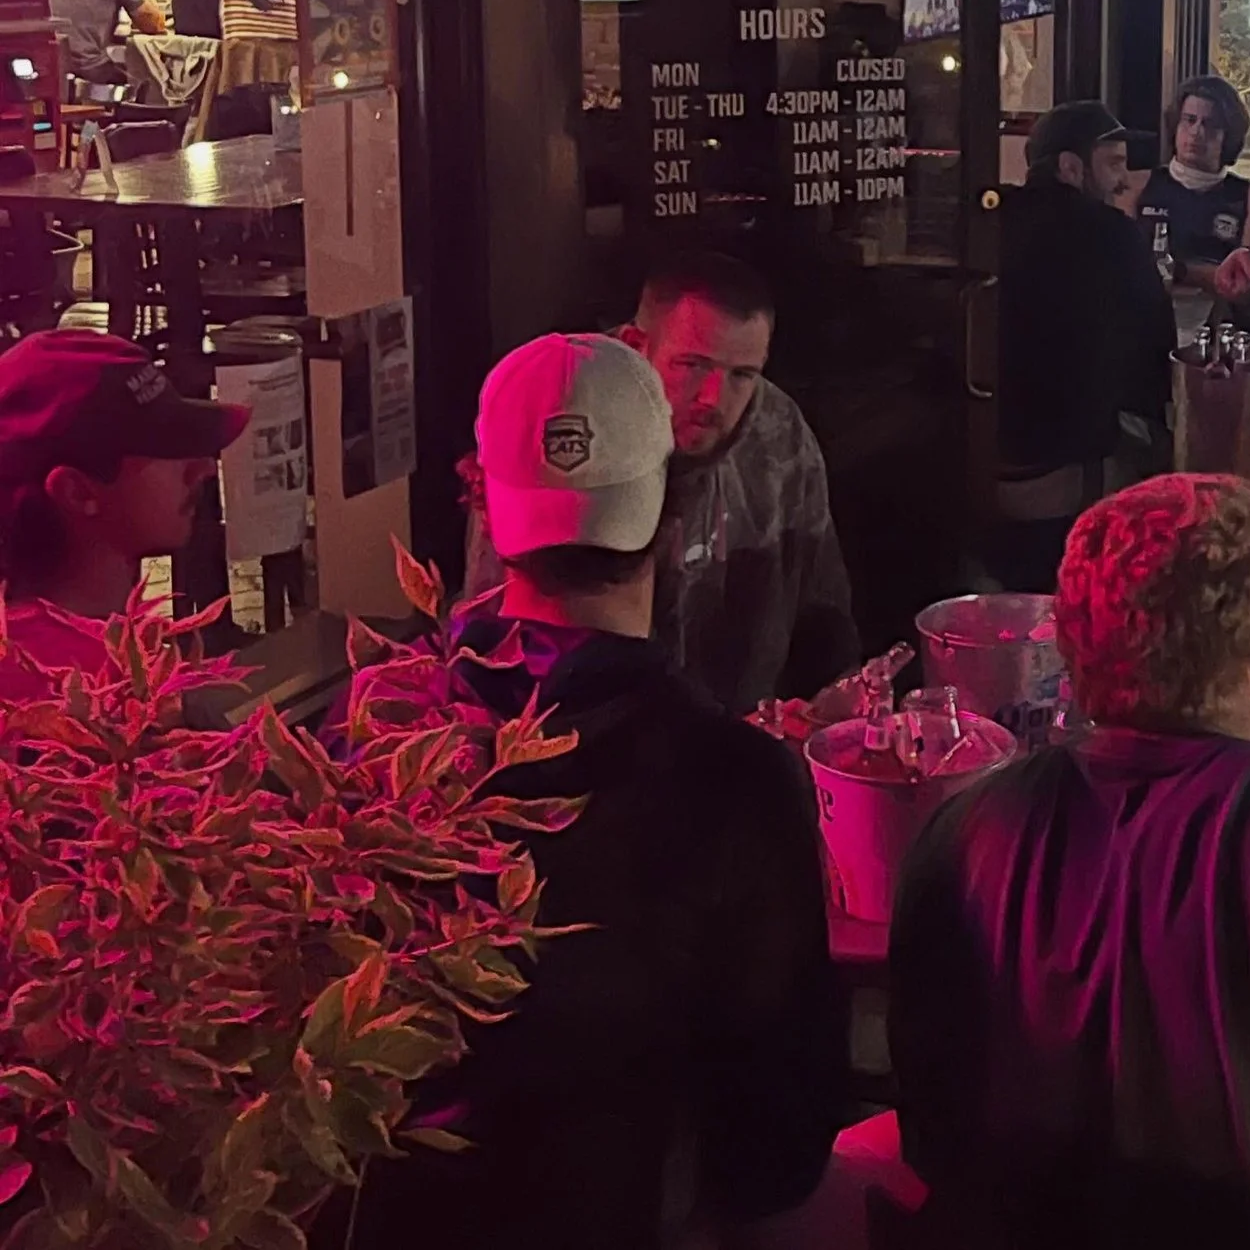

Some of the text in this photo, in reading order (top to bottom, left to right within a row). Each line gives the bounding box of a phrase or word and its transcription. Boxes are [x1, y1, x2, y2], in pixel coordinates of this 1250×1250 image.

[740, 8, 826, 41] HOURS
[652, 58, 905, 88] MON CLOSED
[652, 95, 689, 121] TUE
[707, 93, 745, 117] THU
[766, 90, 839, 115] 4:30PM
[856, 88, 905, 112] 12AM
[654, 128, 685, 151] FRI
[793, 120, 839, 144] 11AM
[857, 116, 905, 140] 12AM
[654, 160, 691, 184] SAT
[794, 150, 840, 175] 11AM
[857, 147, 905, 171] 12AM
[655, 191, 697, 217] SUN
[794, 180, 841, 206] 11AM
[857, 176, 904, 201] 10PM
